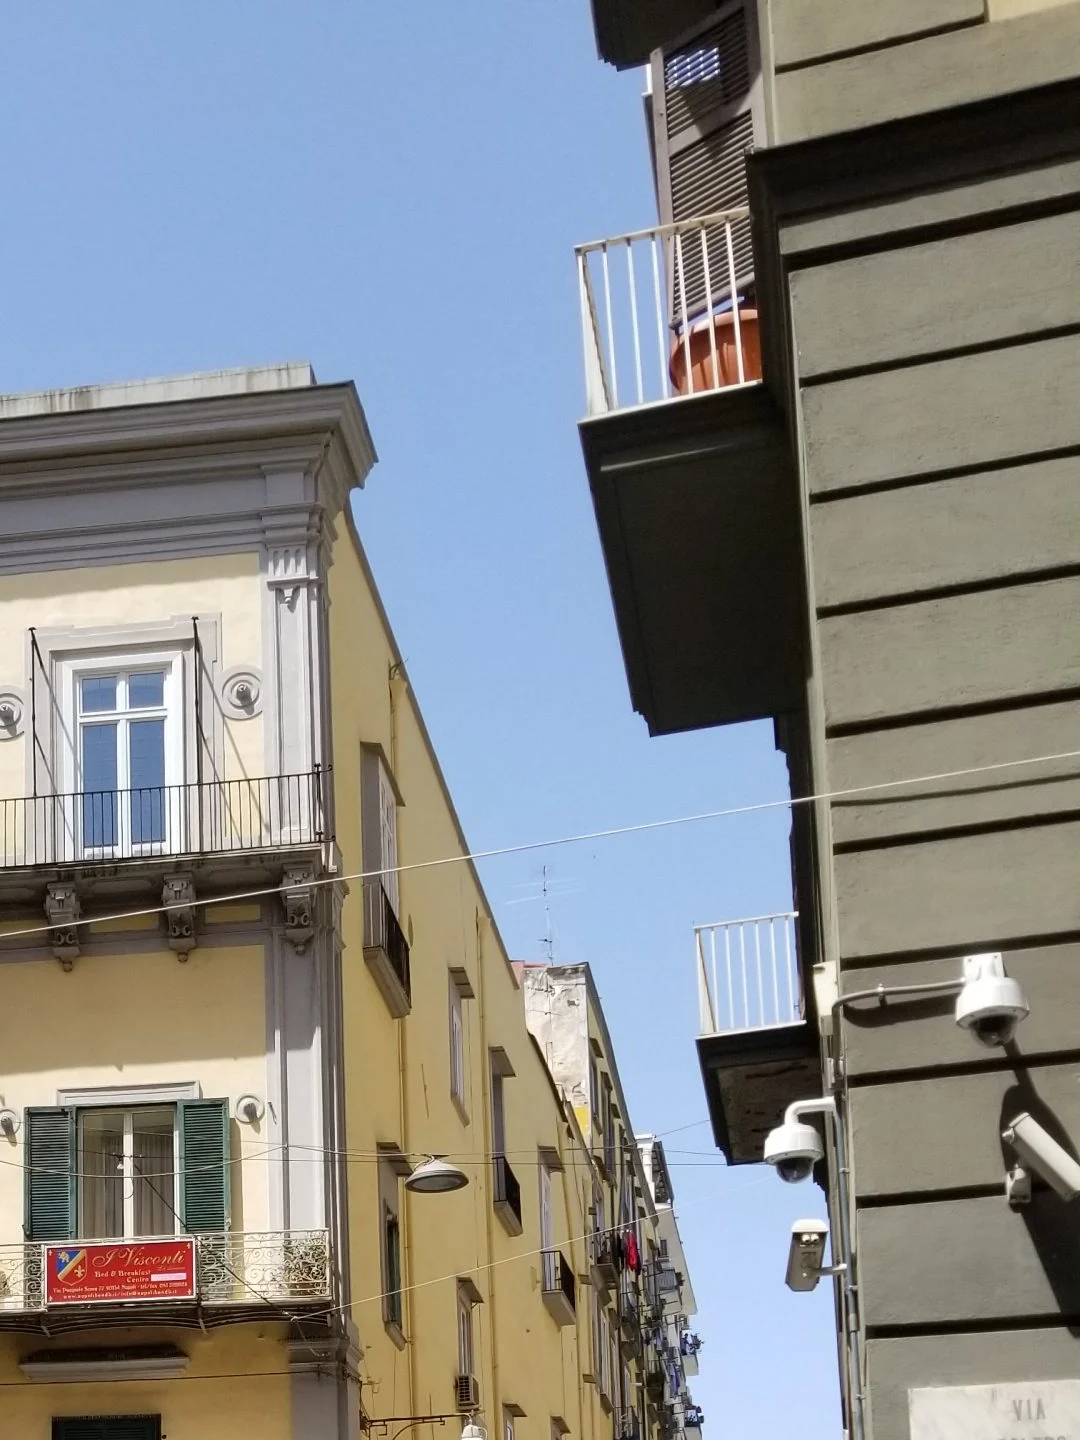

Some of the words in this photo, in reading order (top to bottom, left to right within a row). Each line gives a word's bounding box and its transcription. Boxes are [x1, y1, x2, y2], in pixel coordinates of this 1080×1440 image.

[120, 1247, 186, 1267] Visconti
[118, 1269, 151, 1278] Breakfast
[1012, 1398, 1046, 1422] VIA
